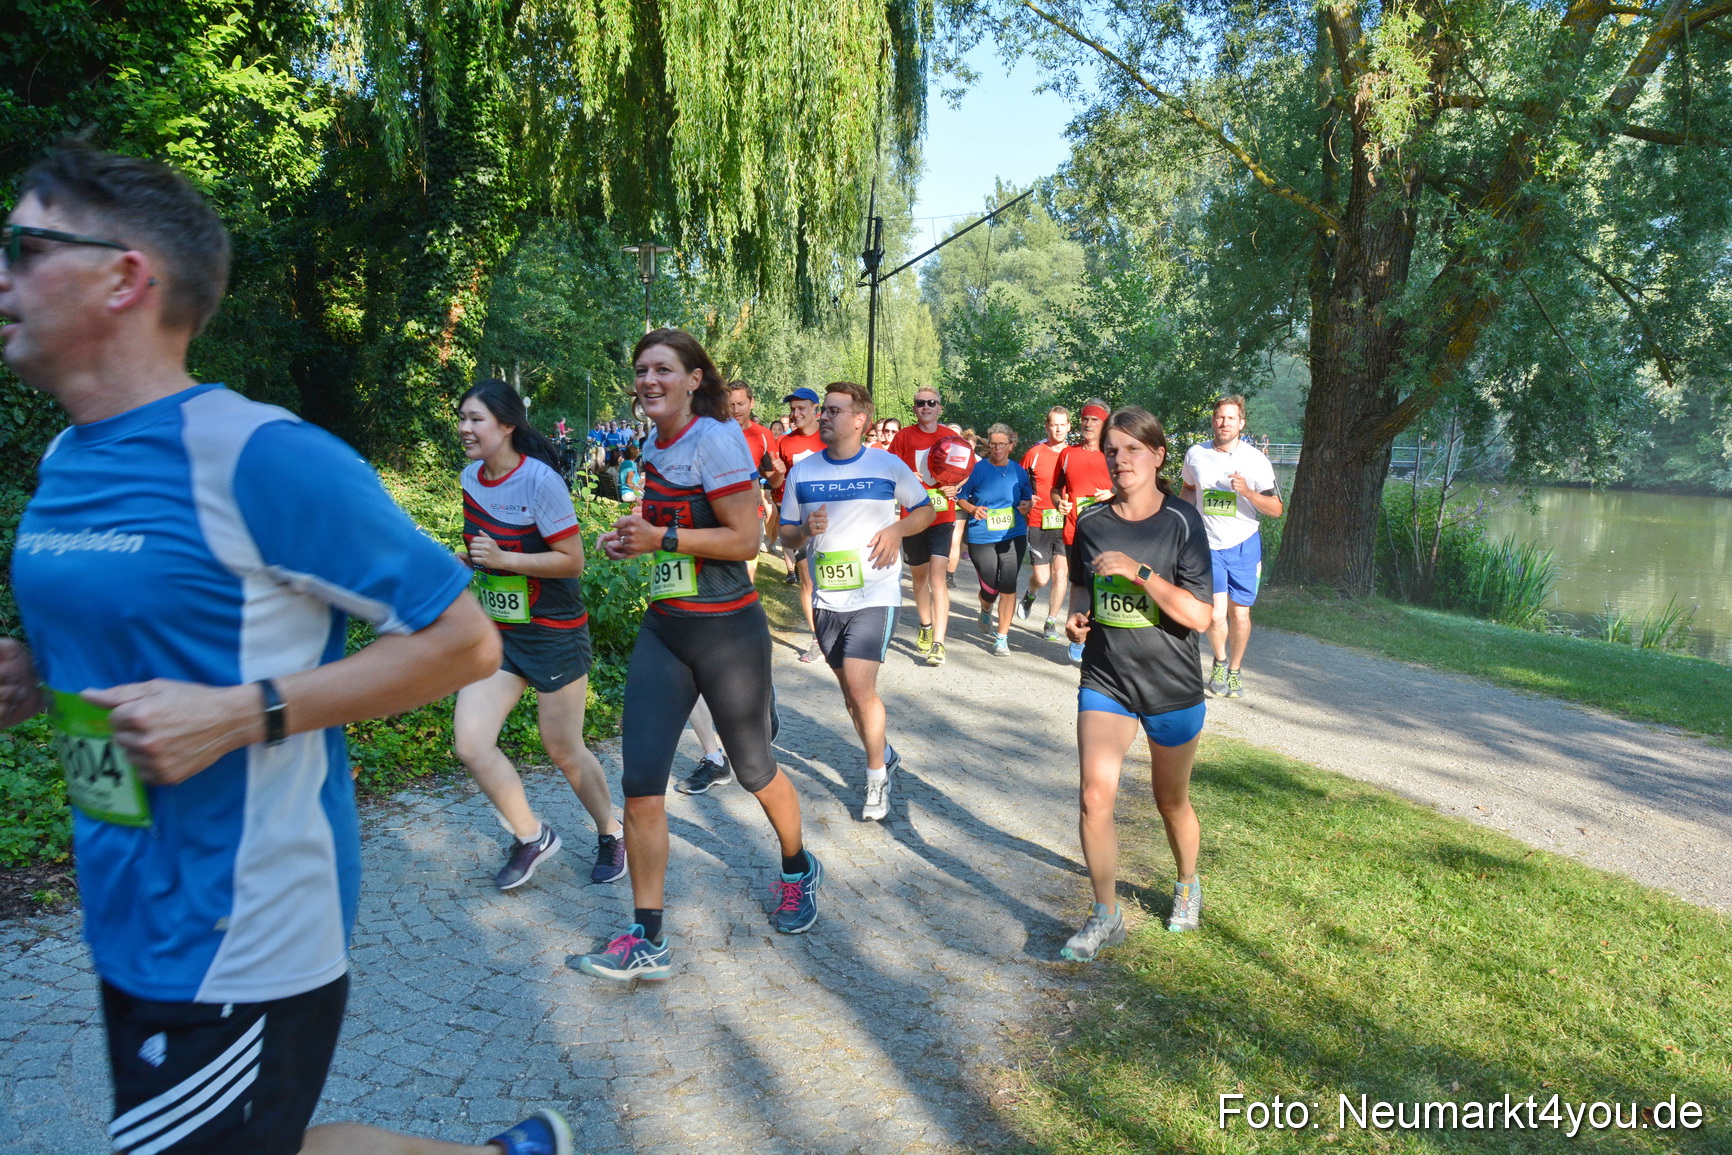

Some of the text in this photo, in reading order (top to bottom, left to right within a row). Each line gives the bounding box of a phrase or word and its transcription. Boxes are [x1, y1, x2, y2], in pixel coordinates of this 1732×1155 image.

[828, 481, 874, 492] PLAST
[490, 503, 521, 512] NEUMARKT
[1206, 498, 1232, 510] 1717
[990, 515, 1012, 525] 1049
[819, 563, 854, 579] 1951
[482, 589, 519, 610] 1898
[1101, 592, 1149, 612] 1664
